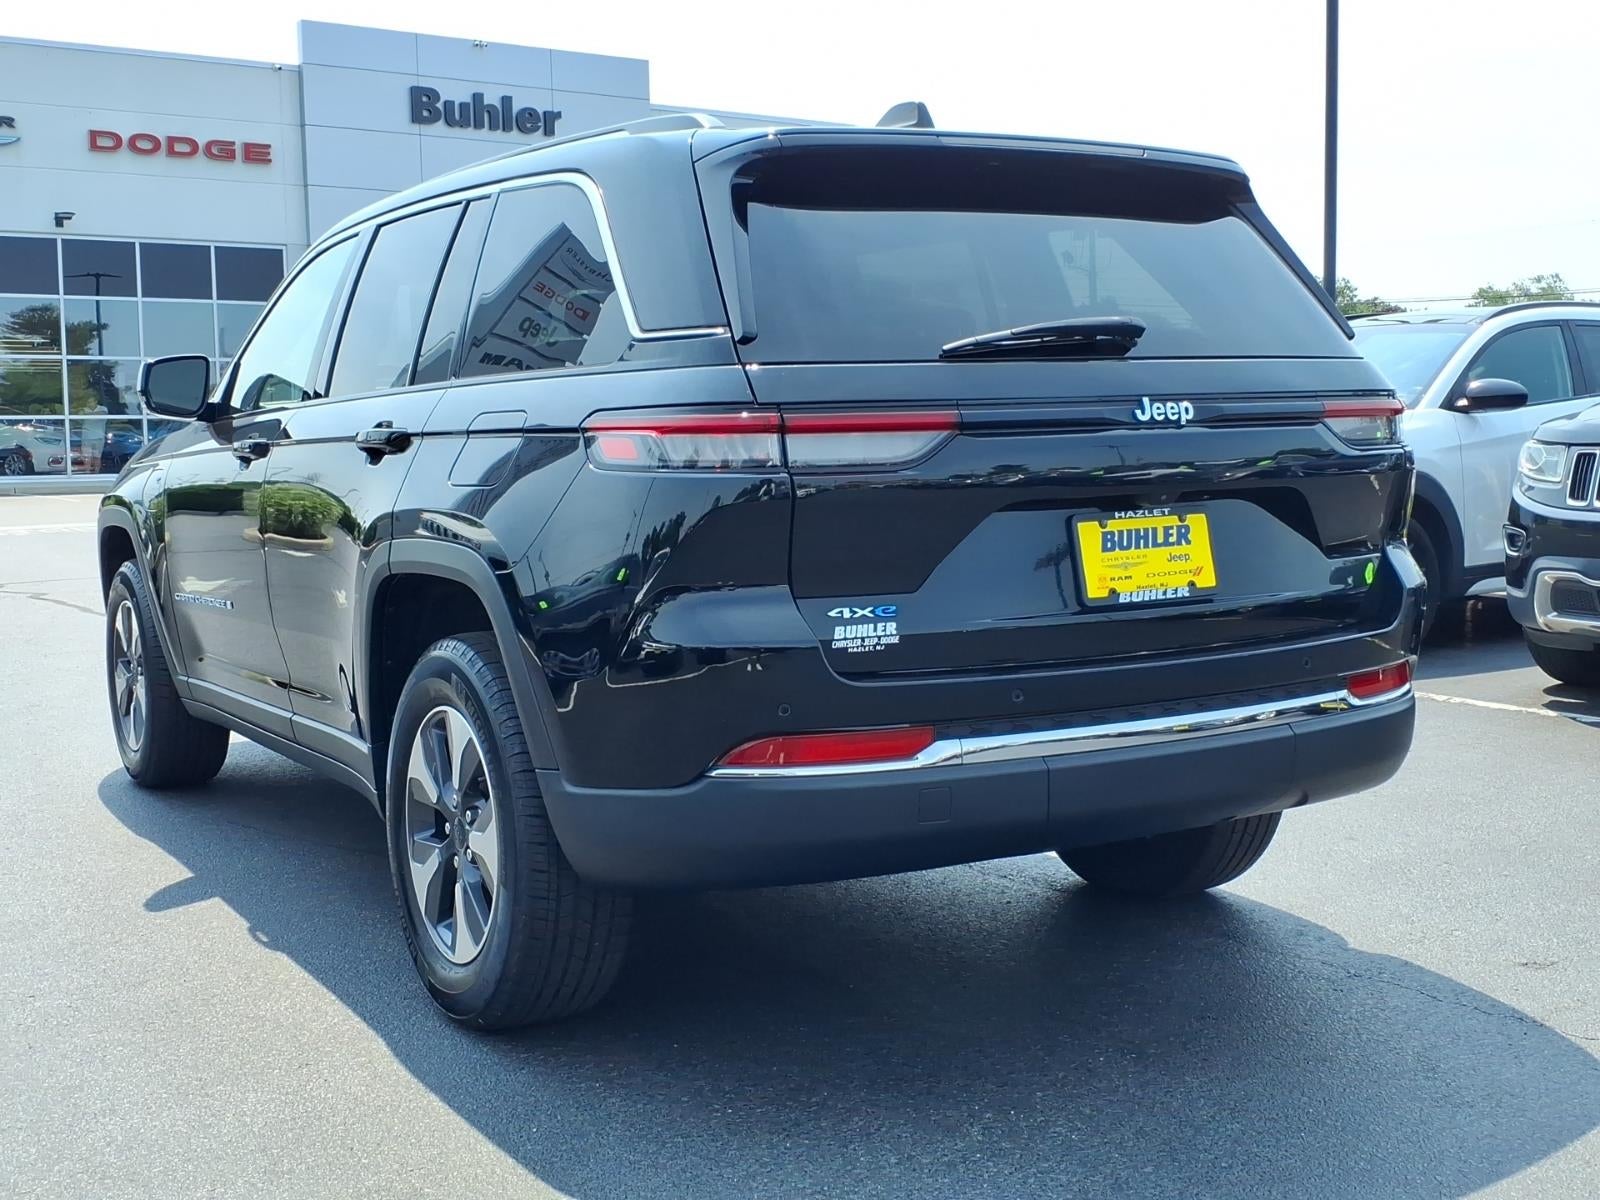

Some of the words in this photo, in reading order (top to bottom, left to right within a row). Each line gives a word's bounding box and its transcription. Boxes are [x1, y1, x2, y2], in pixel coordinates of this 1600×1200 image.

[410, 85, 562, 137] Buhler
[88, 129, 273, 164] DODGE
[1134, 397, 1194, 425] Jeep
[1114, 507, 1172, 519] HAZLET
[1101, 524, 1192, 553] BUHLER
[1101, 553, 1148, 563] CHRYSLER
[1167, 552, 1190, 563] Jeep
[1146, 568, 1197, 578] DODGE
[1119, 586, 1190, 603] BUHLER
[833, 622, 897, 640] BUHLER
